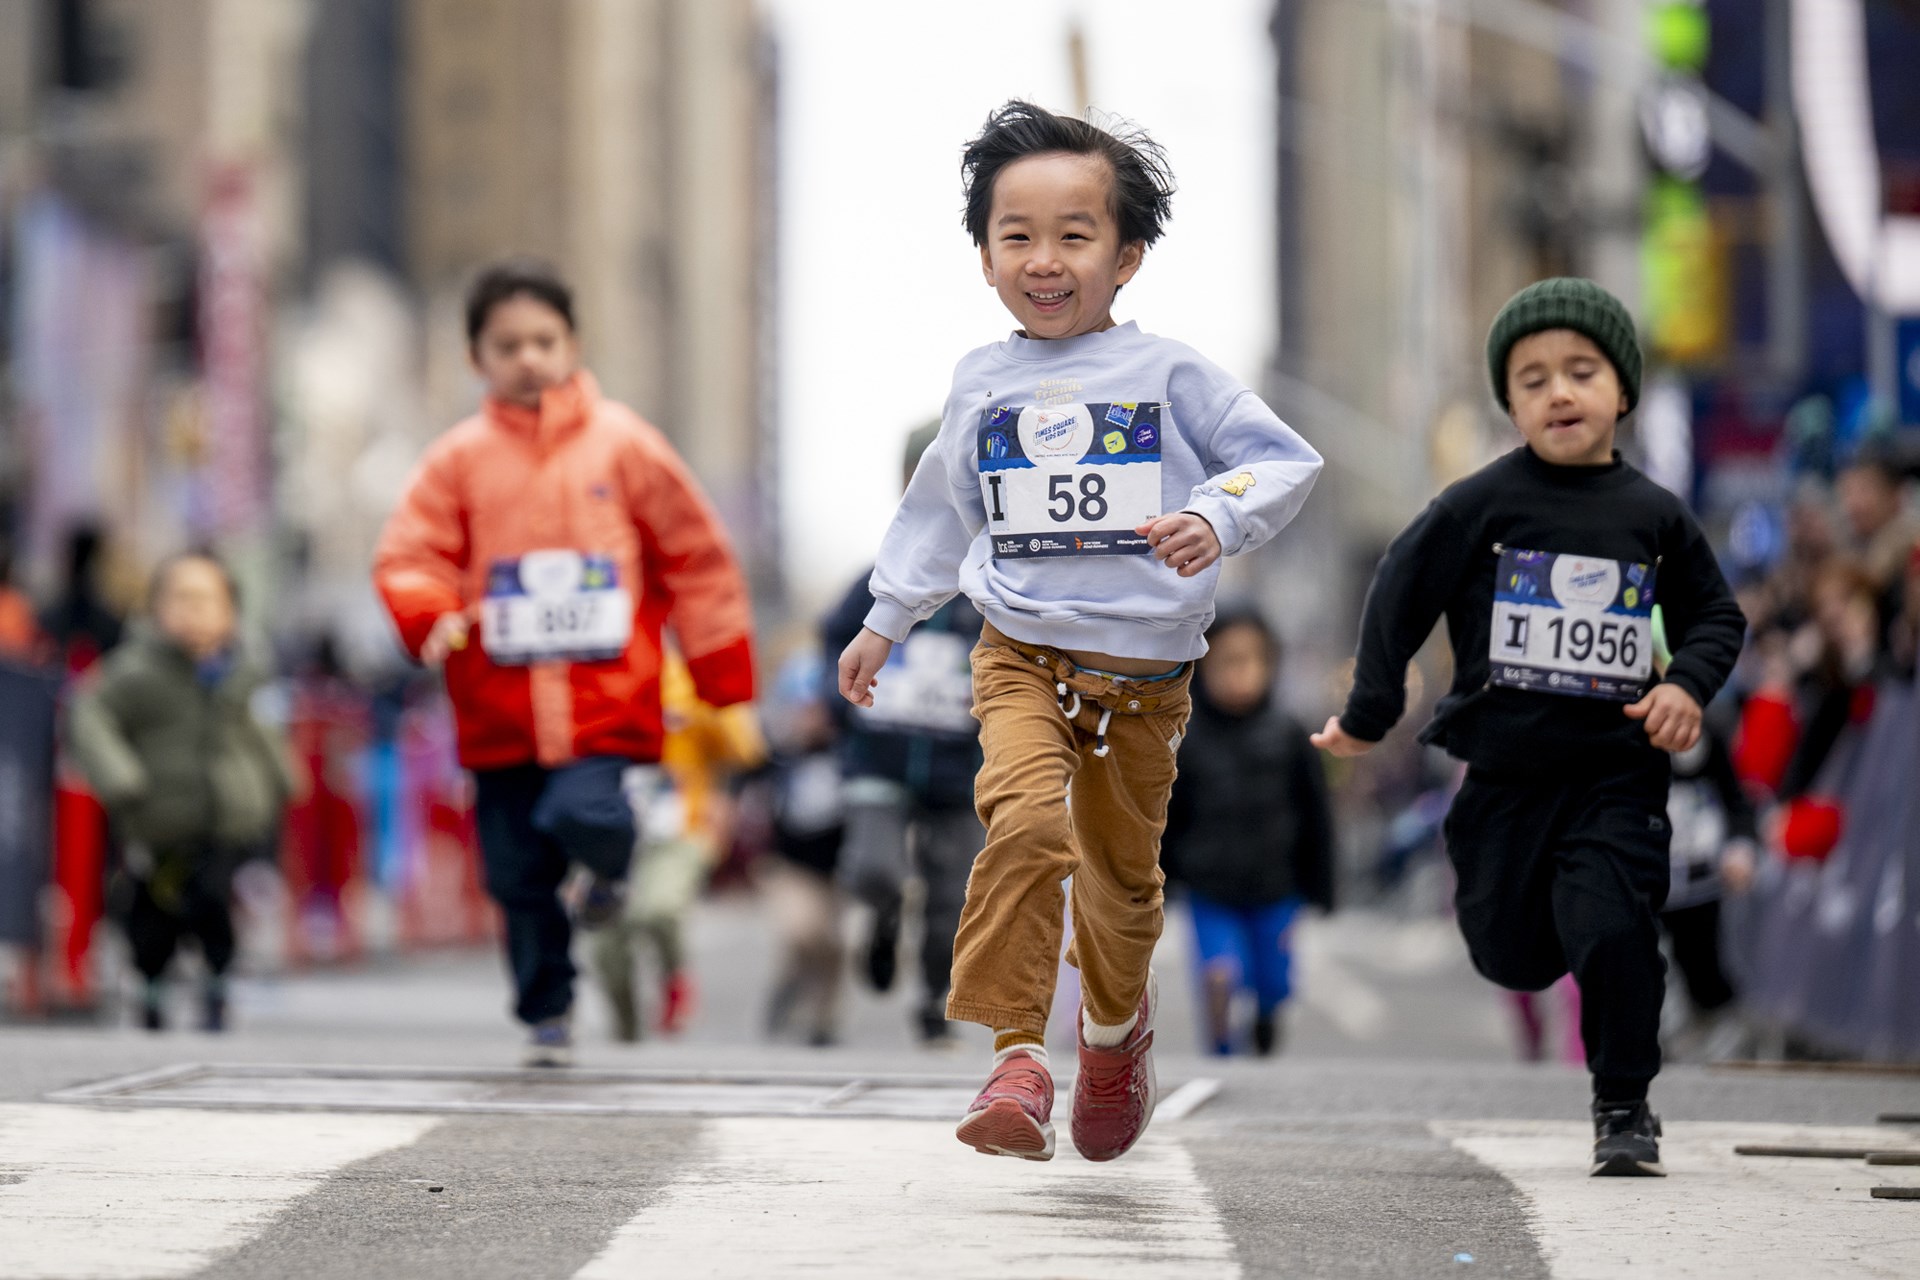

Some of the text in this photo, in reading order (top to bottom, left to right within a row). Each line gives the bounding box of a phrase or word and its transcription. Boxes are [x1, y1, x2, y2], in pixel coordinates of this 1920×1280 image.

[1035, 383, 1083, 400] Friends
[1035, 416, 1075, 439] TIMES SQUARE
[1045, 428, 1067, 442] KIDS RUN
[988, 472, 1108, 523] I 58
[1505, 613, 1638, 668] I 1956
